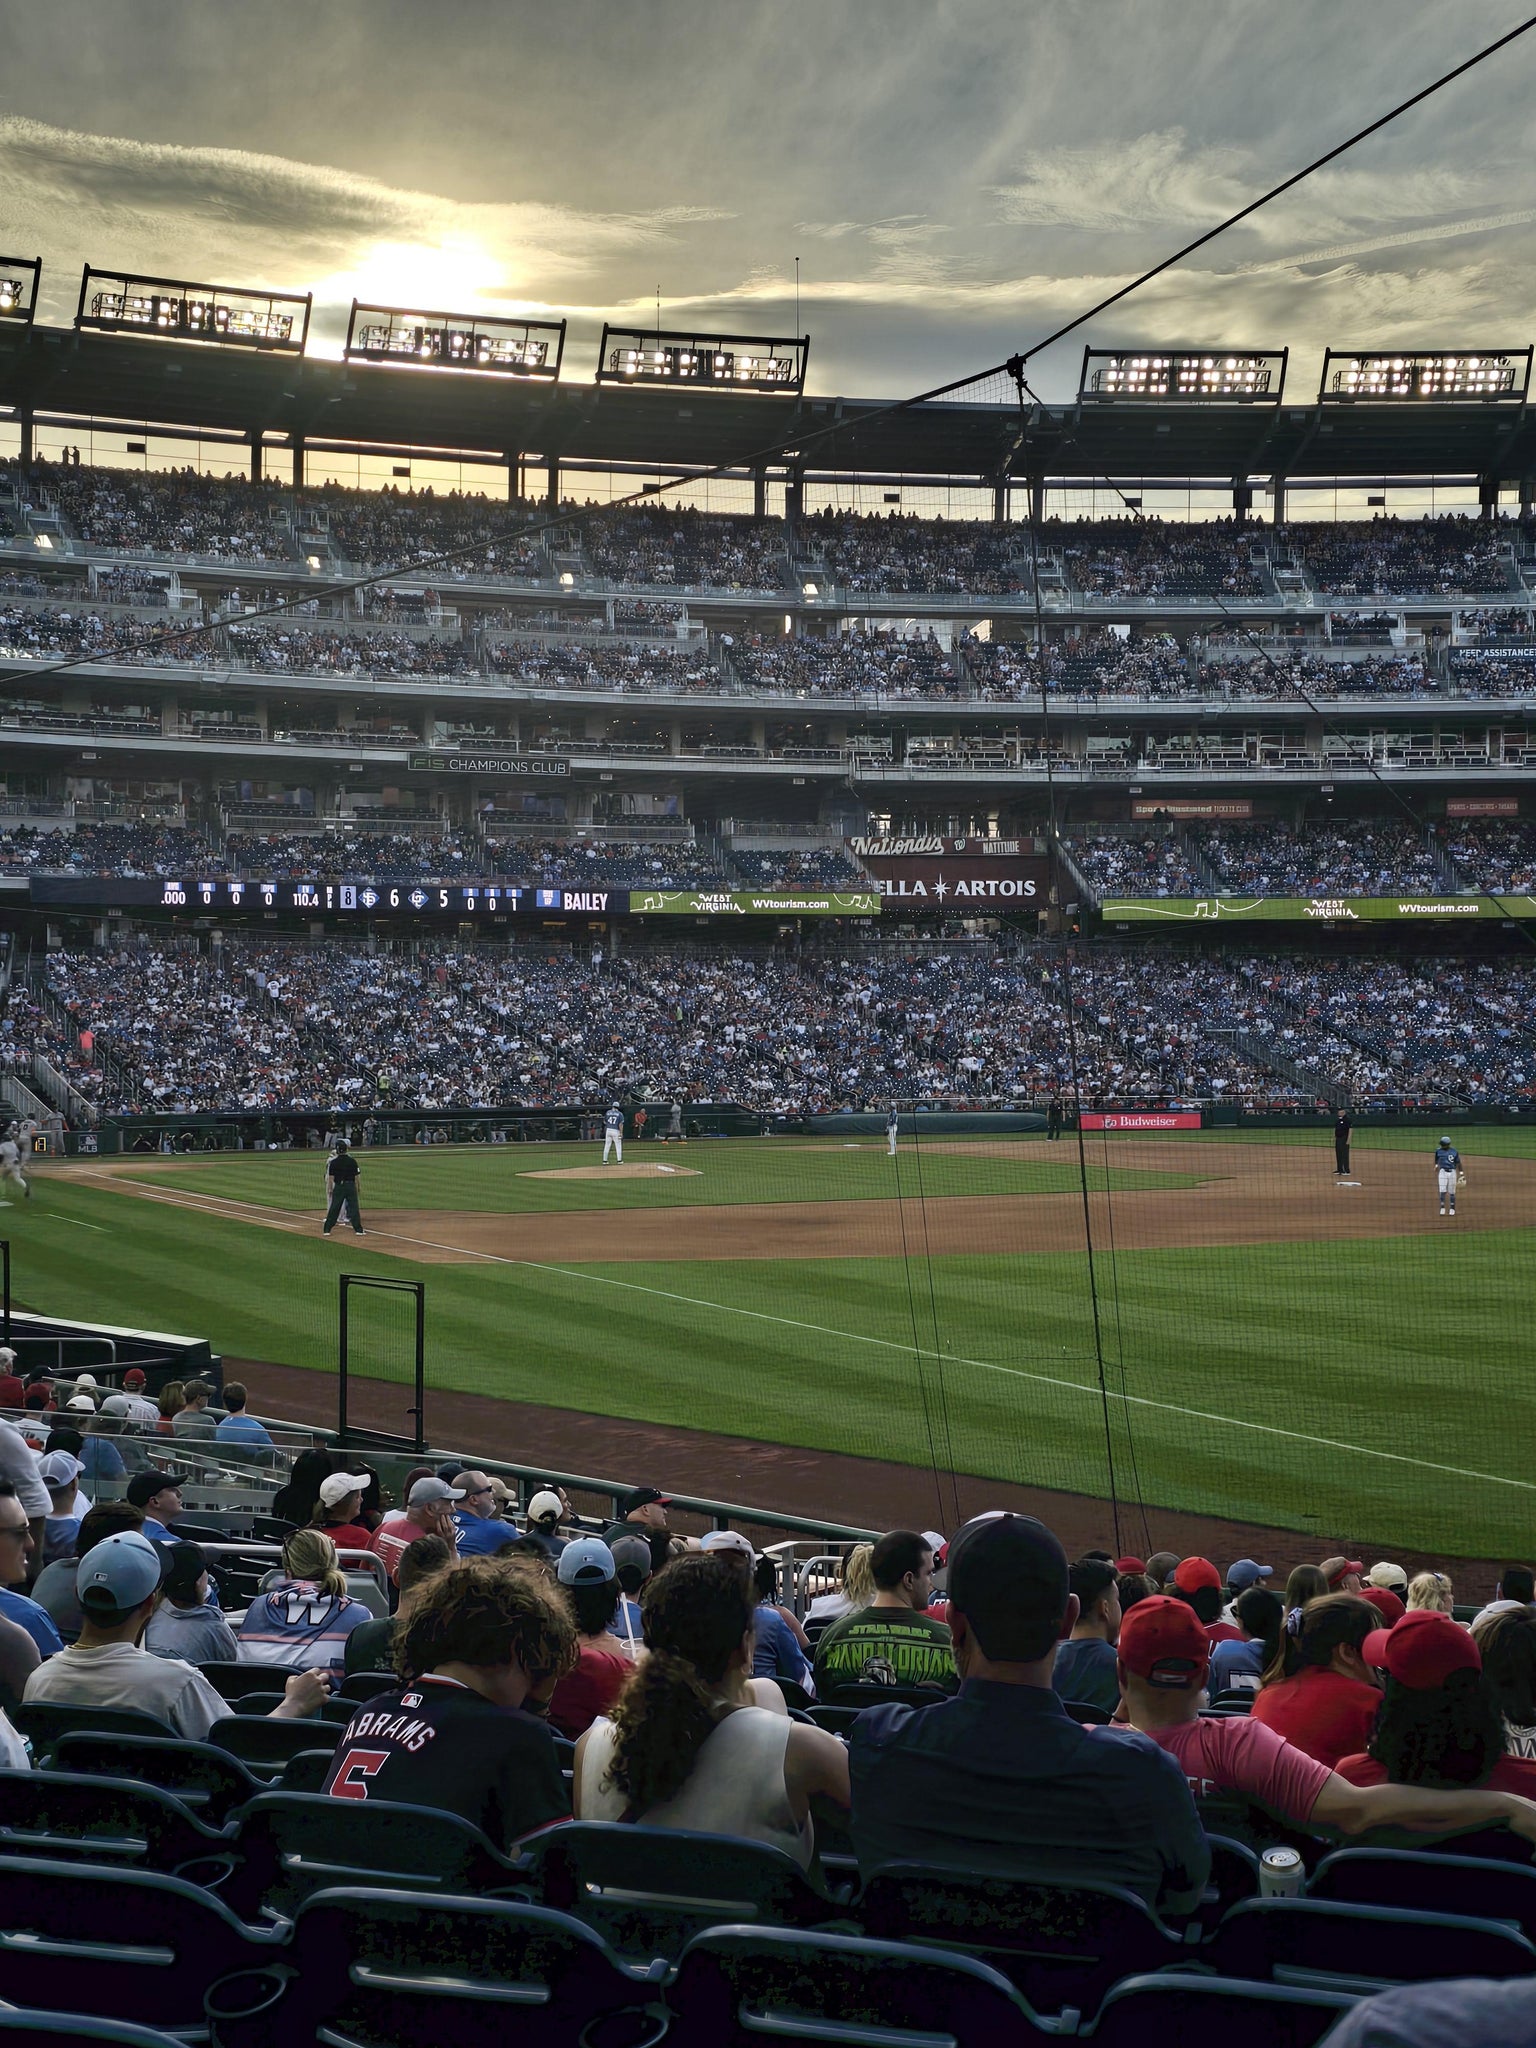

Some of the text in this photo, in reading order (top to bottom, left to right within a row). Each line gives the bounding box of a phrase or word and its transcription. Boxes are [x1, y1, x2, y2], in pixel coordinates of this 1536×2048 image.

[449, 759, 528, 773] CHAMPIONS
[532, 762, 566, 775] CLUB
[850, 836, 944, 855] Nationals
[982, 840, 1020, 854] NATITUDE
[954, 881, 1036, 896] ARTOIS
[161, 892, 186, 905] .000
[203, 891, 211, 904] 0
[232, 892, 240, 904] 0
[265, 892, 272, 905] 0
[293, 893, 319, 907] 110.4
[345, 891, 352, 906] 8
[390, 889, 399, 907] 6
[439, 889, 448, 907] 5
[467, 897, 475, 910] 0
[564, 893, 608, 911] BAILEY
[698, 893, 732, 903] WEST
[489, 898, 496, 911] 0
[511, 898, 517, 911] 1
[690, 901, 746, 914] VIRGINIA
[752, 899, 829, 910] WVtourism.com
[1311, 900, 1345, 909] WEST
[1398, 904, 1479, 914] WVtourism.com
[1303, 907, 1359, 919] VIRGINIA
[607, 1116, 618, 1125] 47
[1120, 1116, 1177, 1127] Budweiser
[78, 1145, 98, 1153] MLB
[848, 1625, 889, 1636] STAR
[341, 1712, 436, 1752] ABRAMS
[329, 1748, 391, 1801] 5
